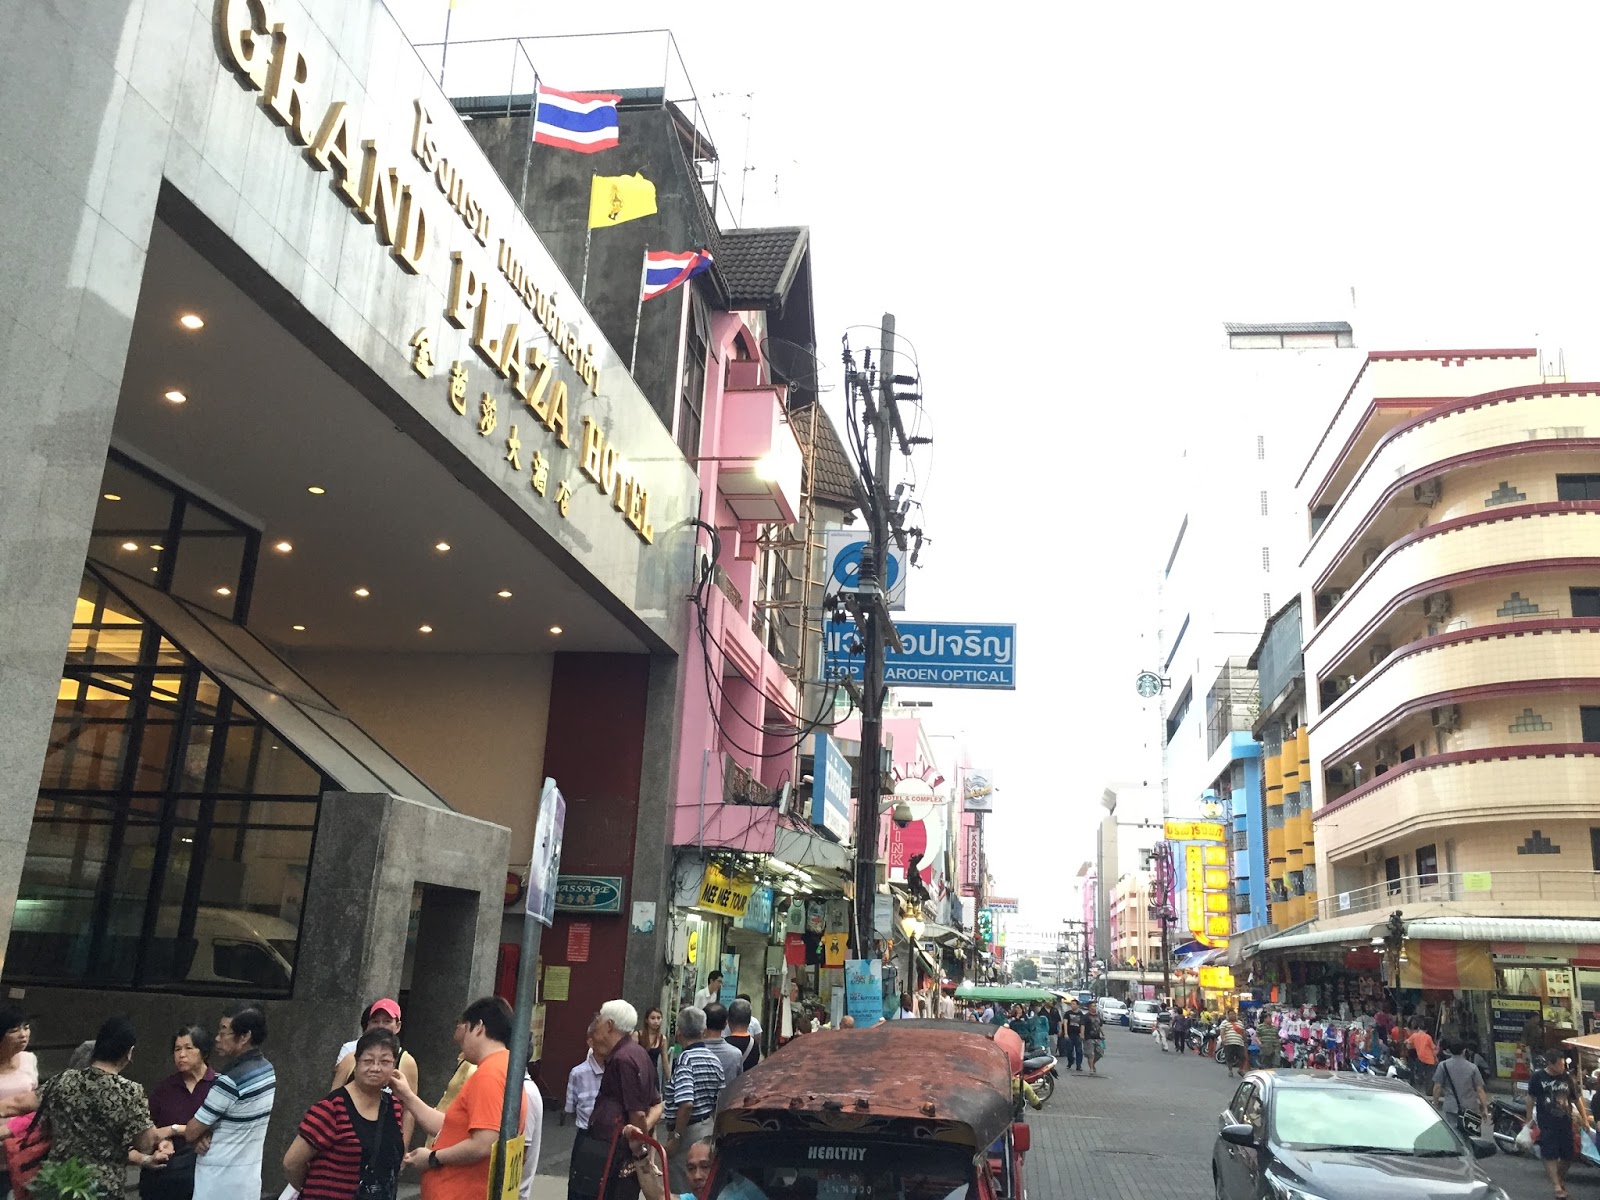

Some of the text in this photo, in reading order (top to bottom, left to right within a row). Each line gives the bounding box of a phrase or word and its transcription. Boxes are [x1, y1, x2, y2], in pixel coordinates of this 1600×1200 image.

[212, 0, 653, 545] GRAND PLAZA HOTEL
[941, 669, 1009, 683] OPTICAL
[911, 795, 943, 803] COMPLEX
[891, 824, 904, 865] INK
[557, 884, 611, 894] ASSAGE
[701, 883, 718, 903] MEE
[718, 887, 731, 907] MEE
[731, 892, 748, 912] TOUR
[807, 1146, 867, 1160] HEALTHY
